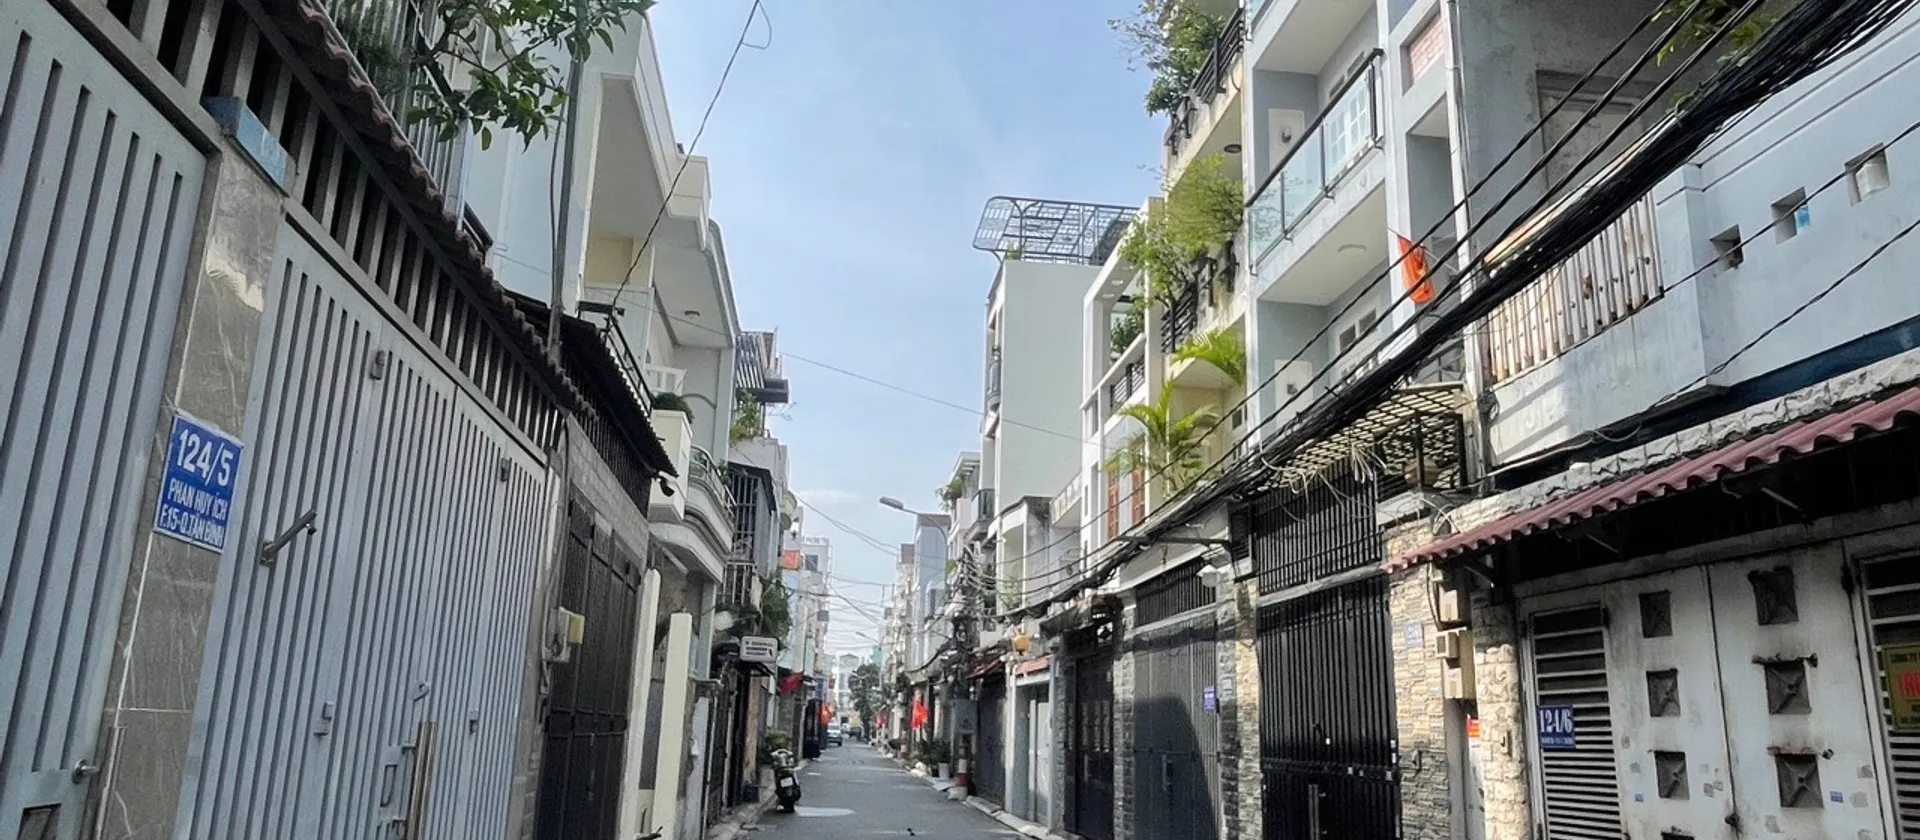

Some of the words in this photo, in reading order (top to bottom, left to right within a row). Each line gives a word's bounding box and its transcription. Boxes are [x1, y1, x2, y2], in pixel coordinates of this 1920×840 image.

[176, 429, 234, 487] 124/5
[168, 477, 196, 508] PHAN
[194, 489, 213, 516] HUY
[1540, 709, 1573, 733] 124/6
